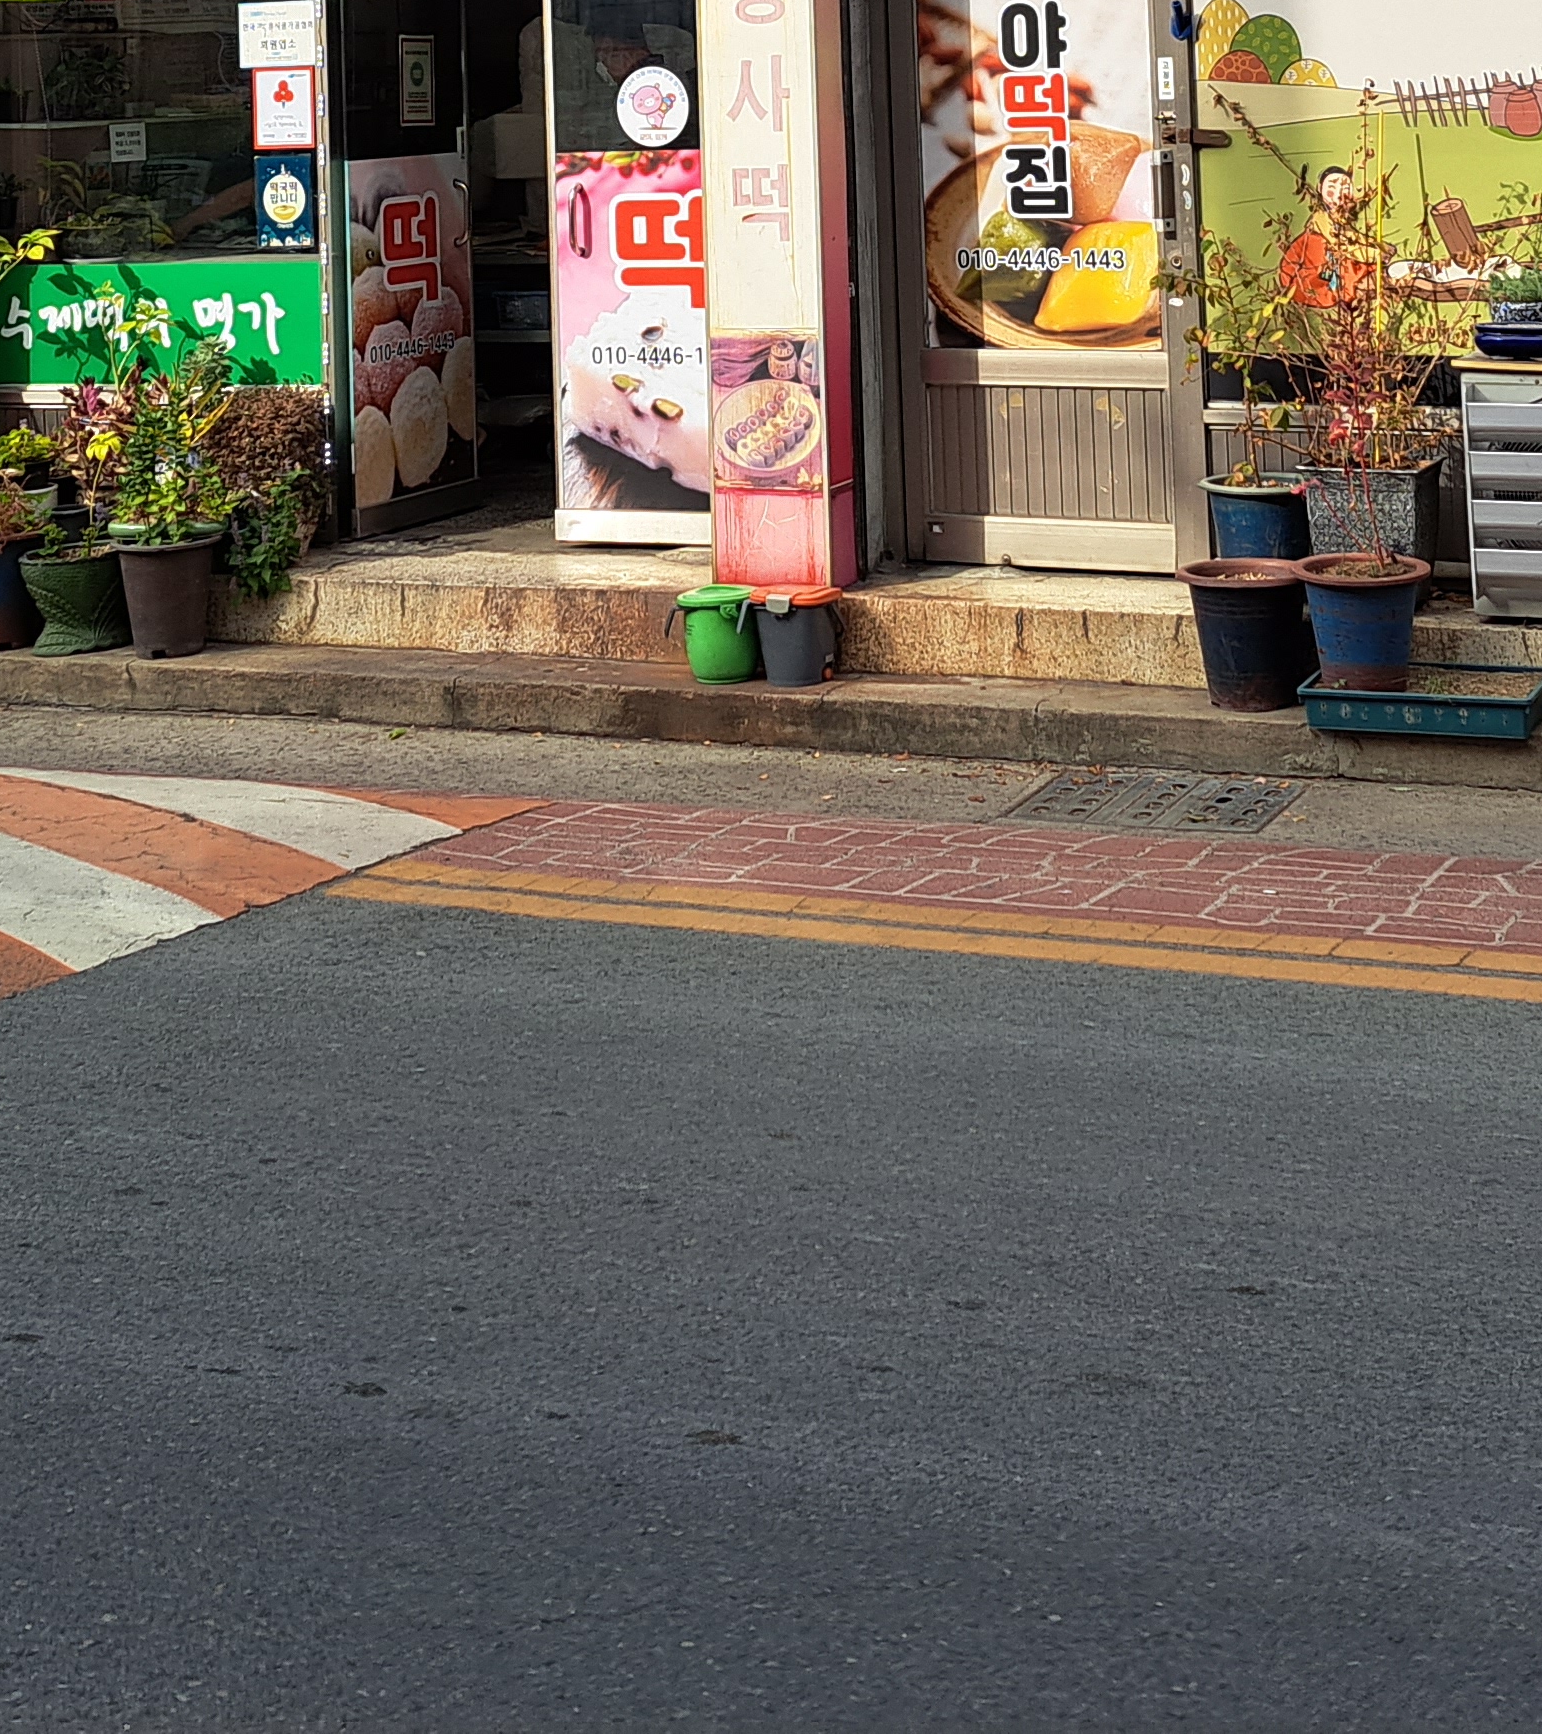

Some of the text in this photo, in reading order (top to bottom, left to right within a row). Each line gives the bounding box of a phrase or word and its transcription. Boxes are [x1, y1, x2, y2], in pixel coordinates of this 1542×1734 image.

[383, 196, 440, 303] 떡
[614, 195, 706, 309] 떡
[957, 247, 1126, 271] 010-4446-1443
[191, 291, 286, 355] 명가
[369, 331, 456, 365] 010-4446-1443
